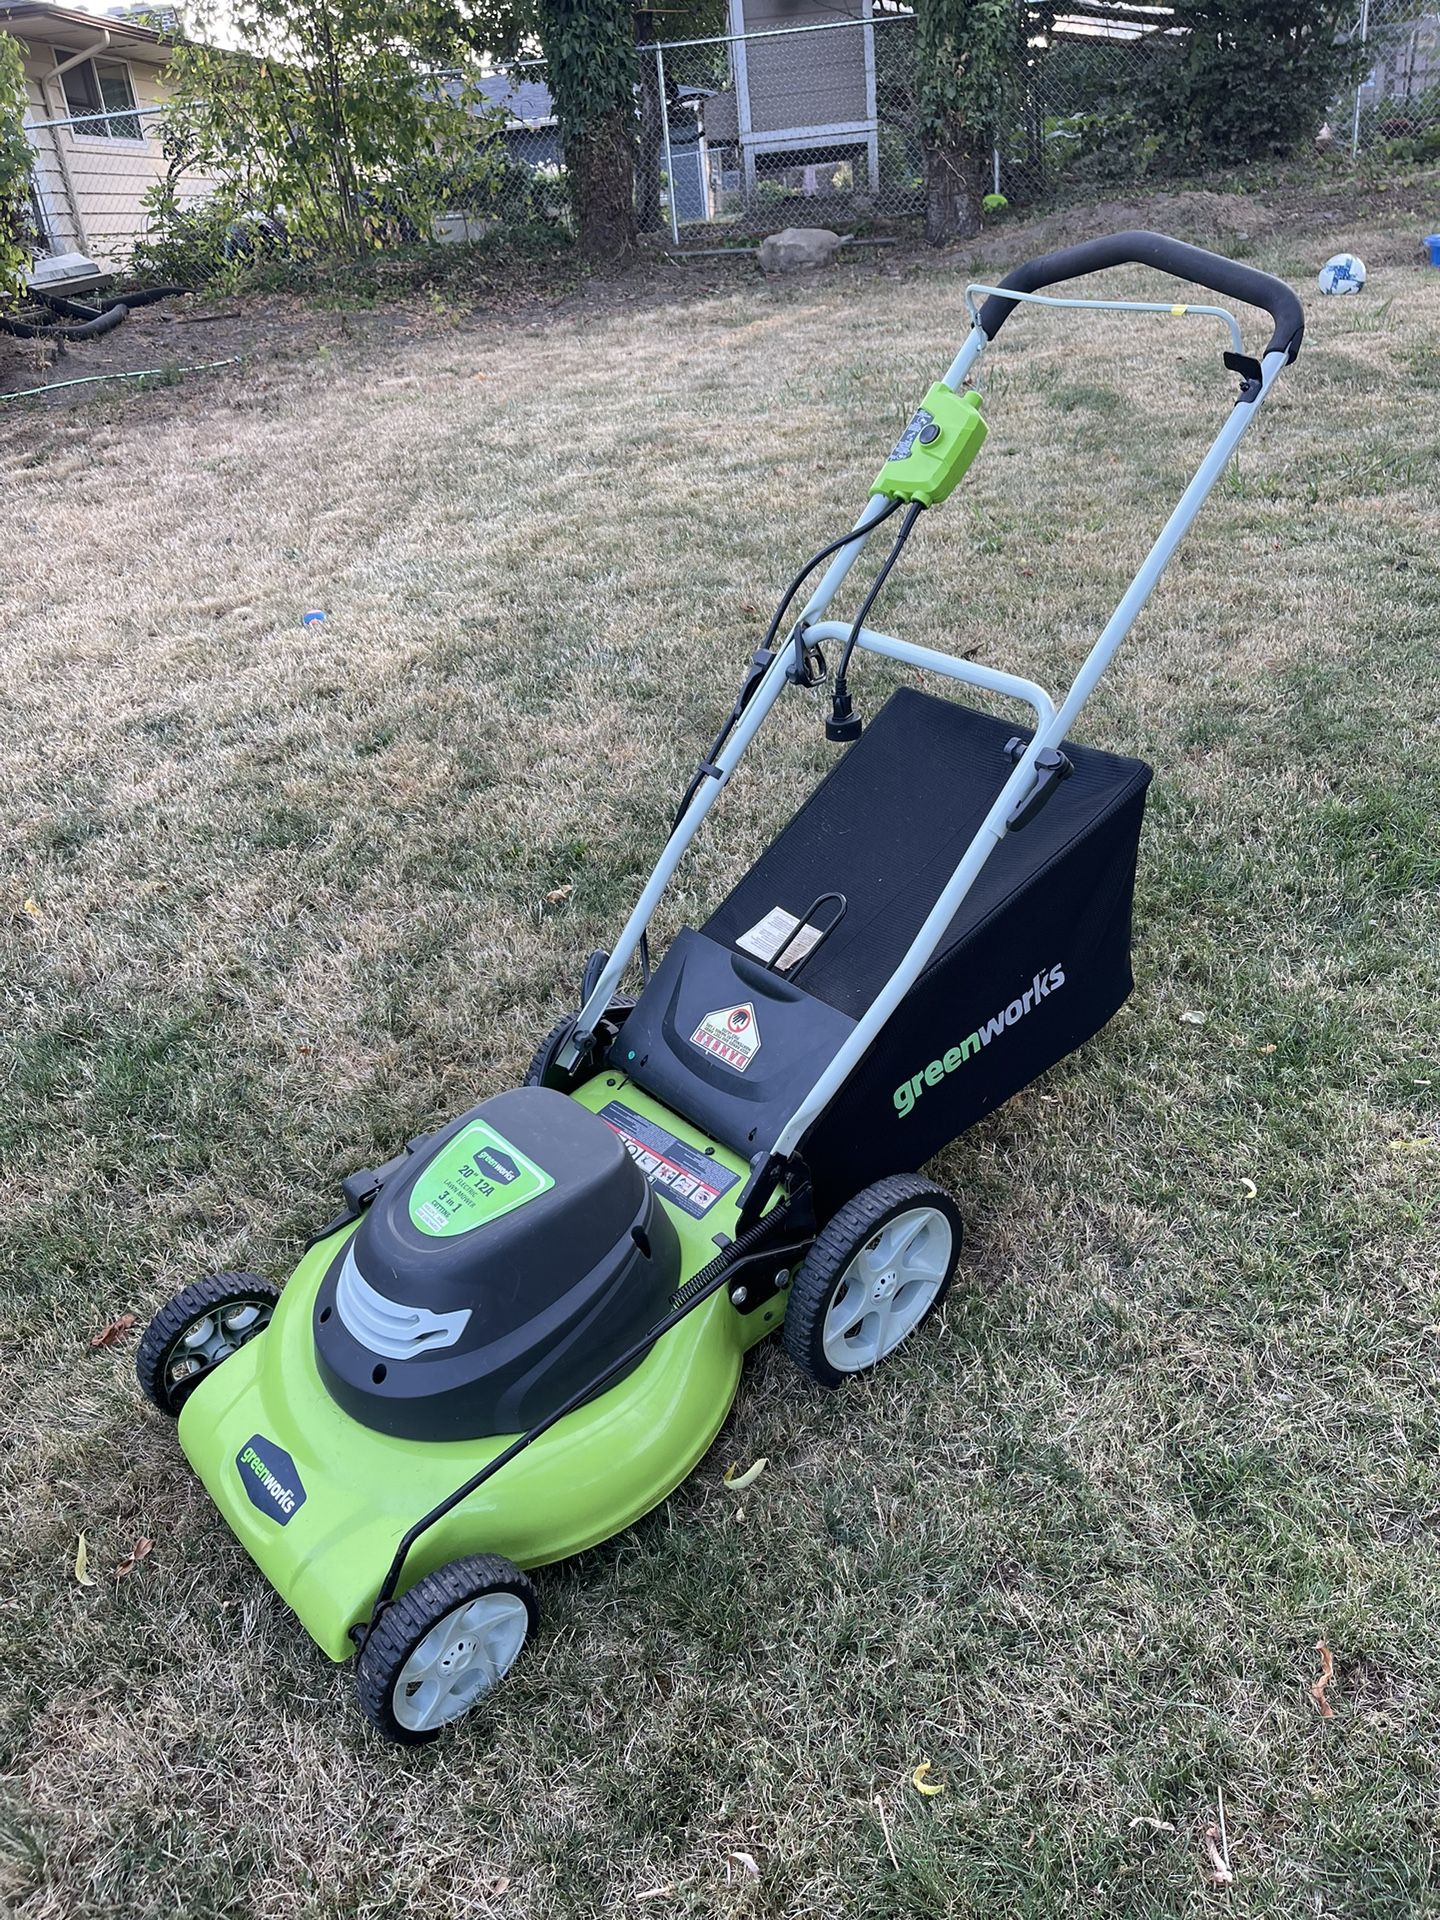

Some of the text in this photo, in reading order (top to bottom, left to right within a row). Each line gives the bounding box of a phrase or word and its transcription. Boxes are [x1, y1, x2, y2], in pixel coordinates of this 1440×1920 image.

[695, 1030, 747, 1067] DANGER
[893, 963, 1065, 1119] greenworks
[477, 1151, 516, 1181] greenworks
[438, 1190, 462, 1213] 3 in 1
[443, 1179, 476, 1209] LAWN MOWER
[456, 1178, 478, 1198] ELECTRIC
[474, 1178, 495, 1197] 12A
[240, 1447, 295, 1513] greenworks
